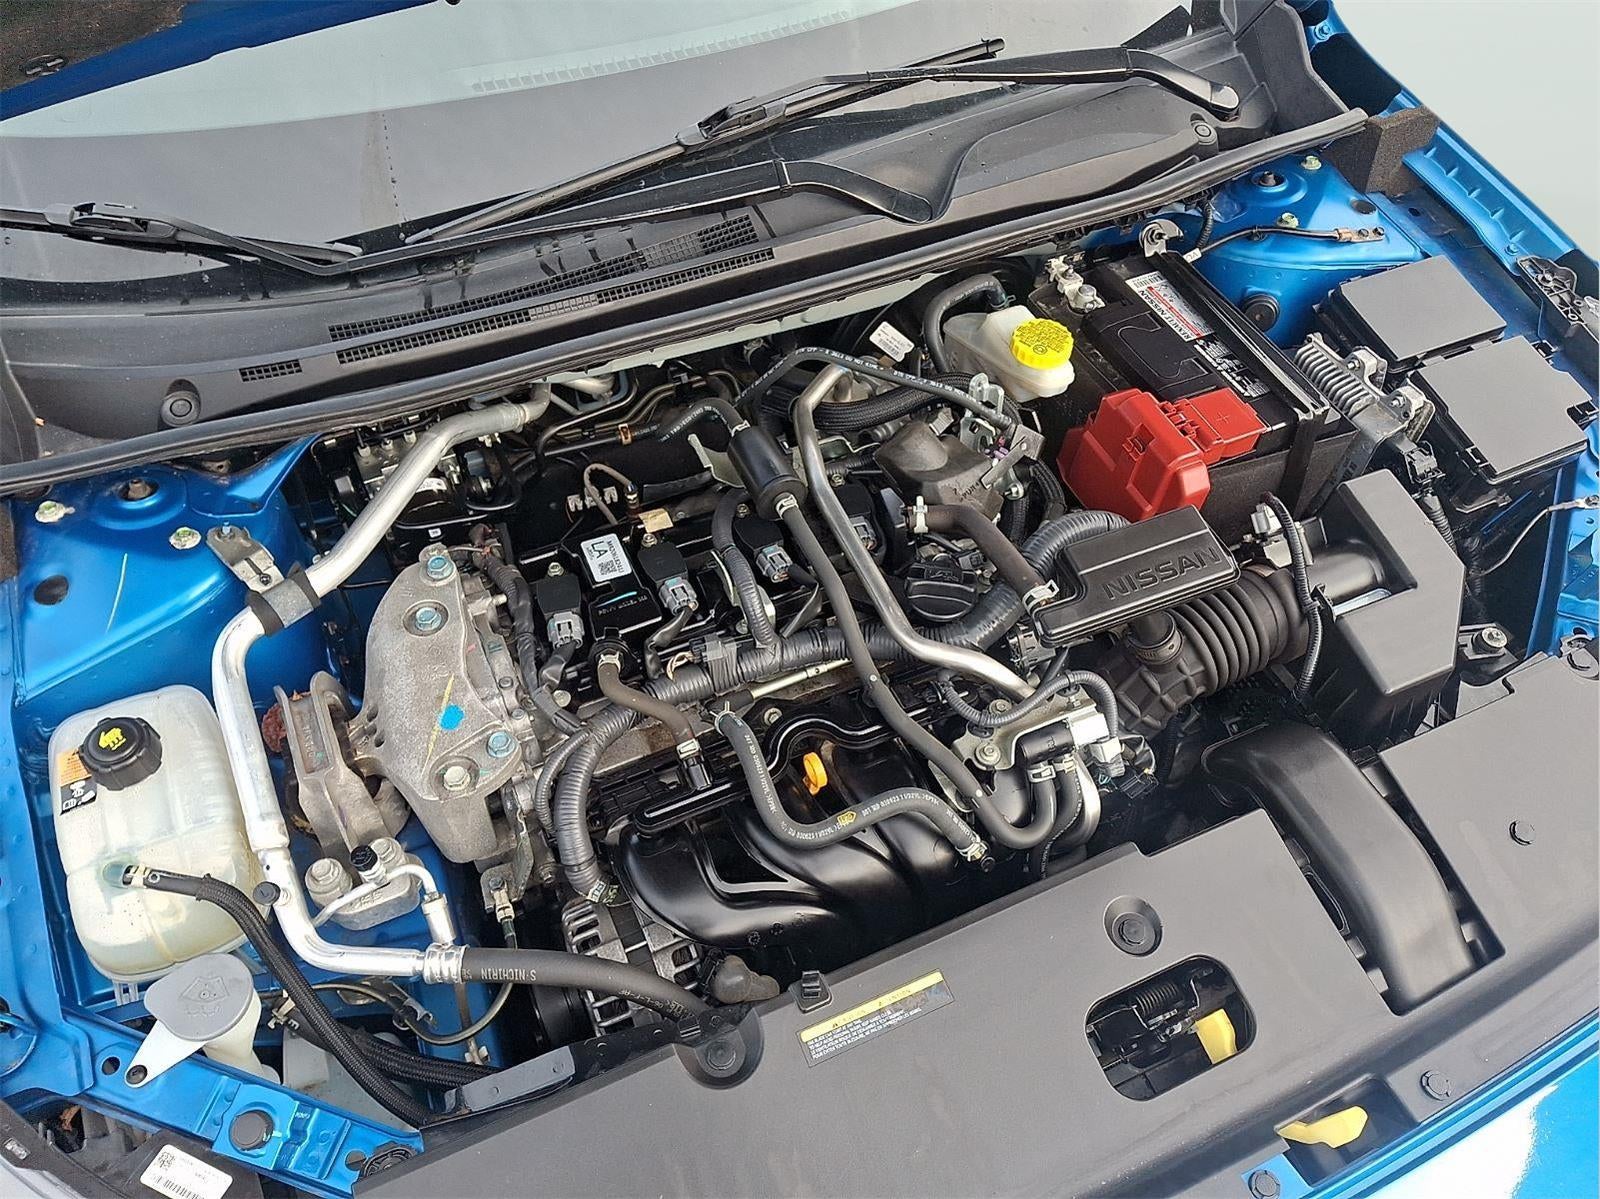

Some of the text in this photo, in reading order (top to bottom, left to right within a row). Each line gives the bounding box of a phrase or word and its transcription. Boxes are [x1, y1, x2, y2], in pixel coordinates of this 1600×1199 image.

[1137, 289, 1166, 315] NISSAN
[1164, 314, 1191, 341] RENAULT
[1102, 547, 1222, 600] NISSAN
